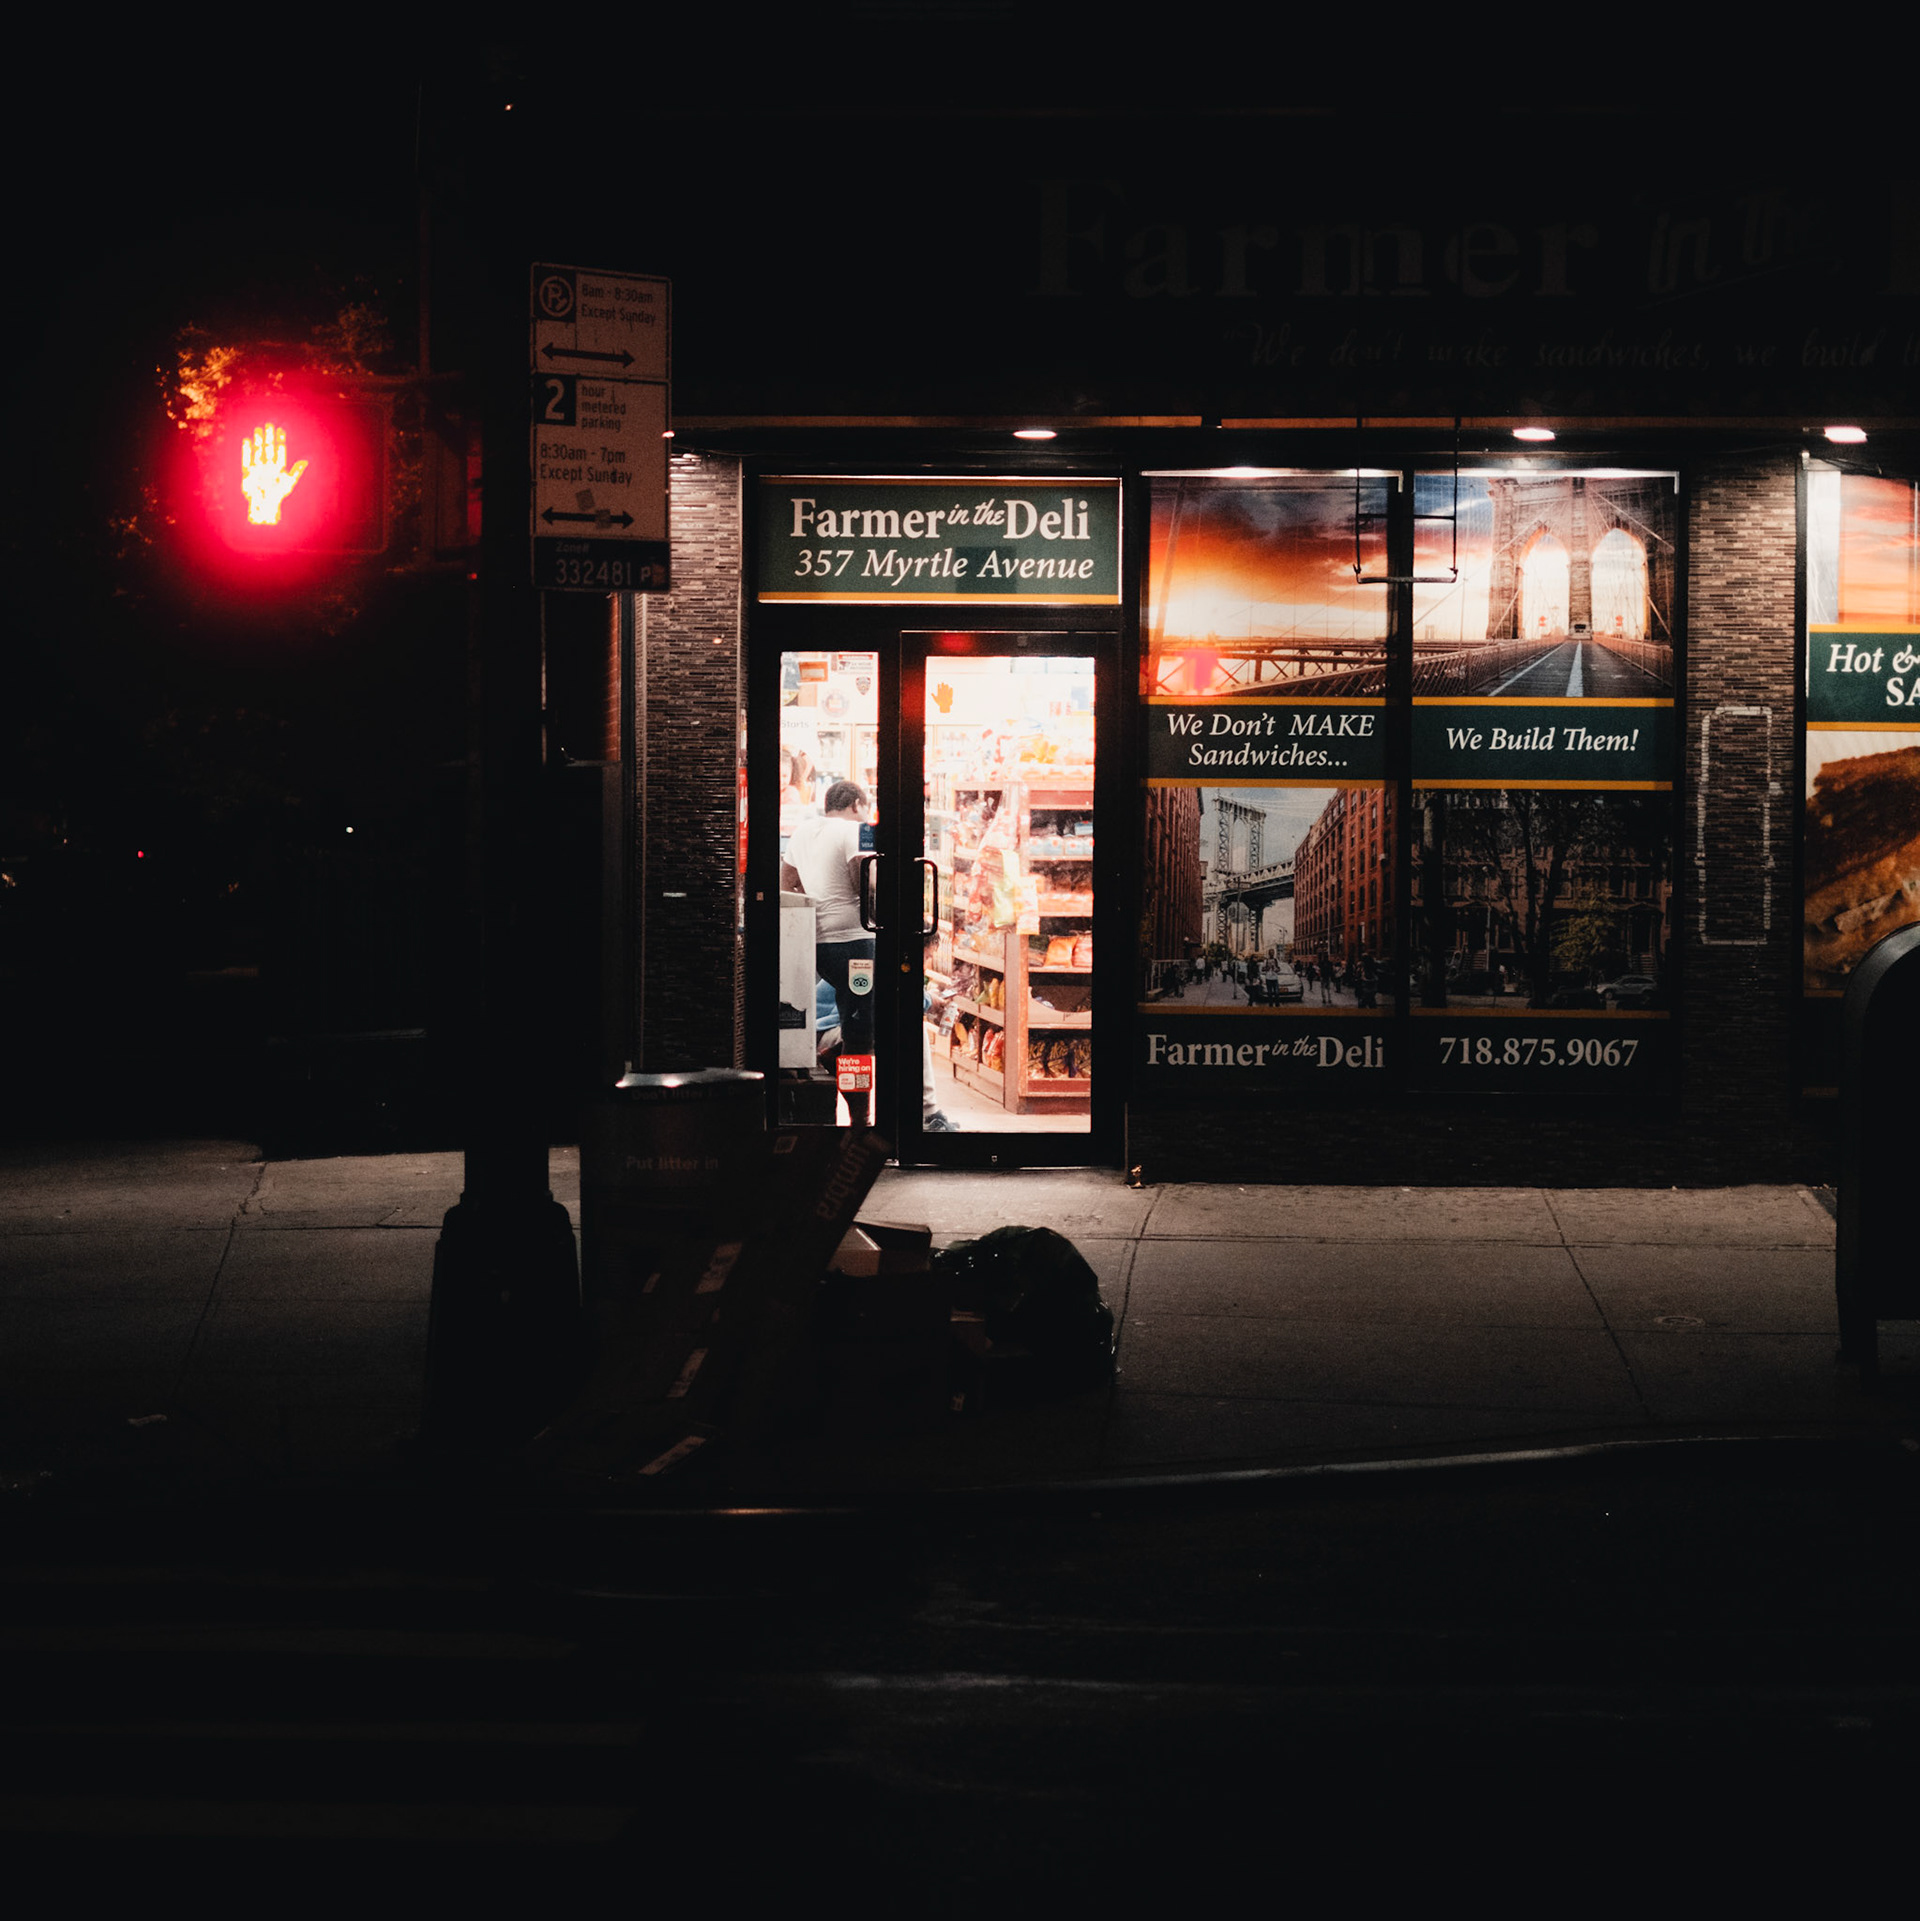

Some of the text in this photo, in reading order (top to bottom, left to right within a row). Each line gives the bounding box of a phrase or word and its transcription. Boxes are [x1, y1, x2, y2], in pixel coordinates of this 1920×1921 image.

[1025, 178, 1598, 298] Farmer
[1648, 211, 1721, 293] in
[581, 284, 604, 298] 8am
[614, 287, 653, 302] 8:30am
[581, 304, 657, 326] Except Sunday
[1801, 327, 1887, 367] build
[544, 378, 566, 421] 2
[581, 384, 606, 398] hour
[581, 401, 626, 415] metered
[581, 416, 621, 431] parking
[540, 443, 587, 461] 8:30am
[600, 446, 626, 465] 7pm
[540, 464, 633, 487] Except Sunday
[790, 498, 1091, 541] Farmer in the Deli
[555, 558, 633, 585] 332481
[794, 547, 1095, 587] 357 Myrtle Avenue
[1825, 643, 1920, 673] Hot &
[1167, 713, 1375, 738] We Don't MAKE
[1446, 726, 1639, 752] We Build Them!
[1188, 742, 1348, 767] Sandwiches...
[1146, 1034, 1385, 1068] Farmer in the Deli
[1439, 1036, 1640, 1067] 718.875.9067
[838, 1065, 860, 1073] hiring
[626, 1154, 719, 1170] Put litter in
